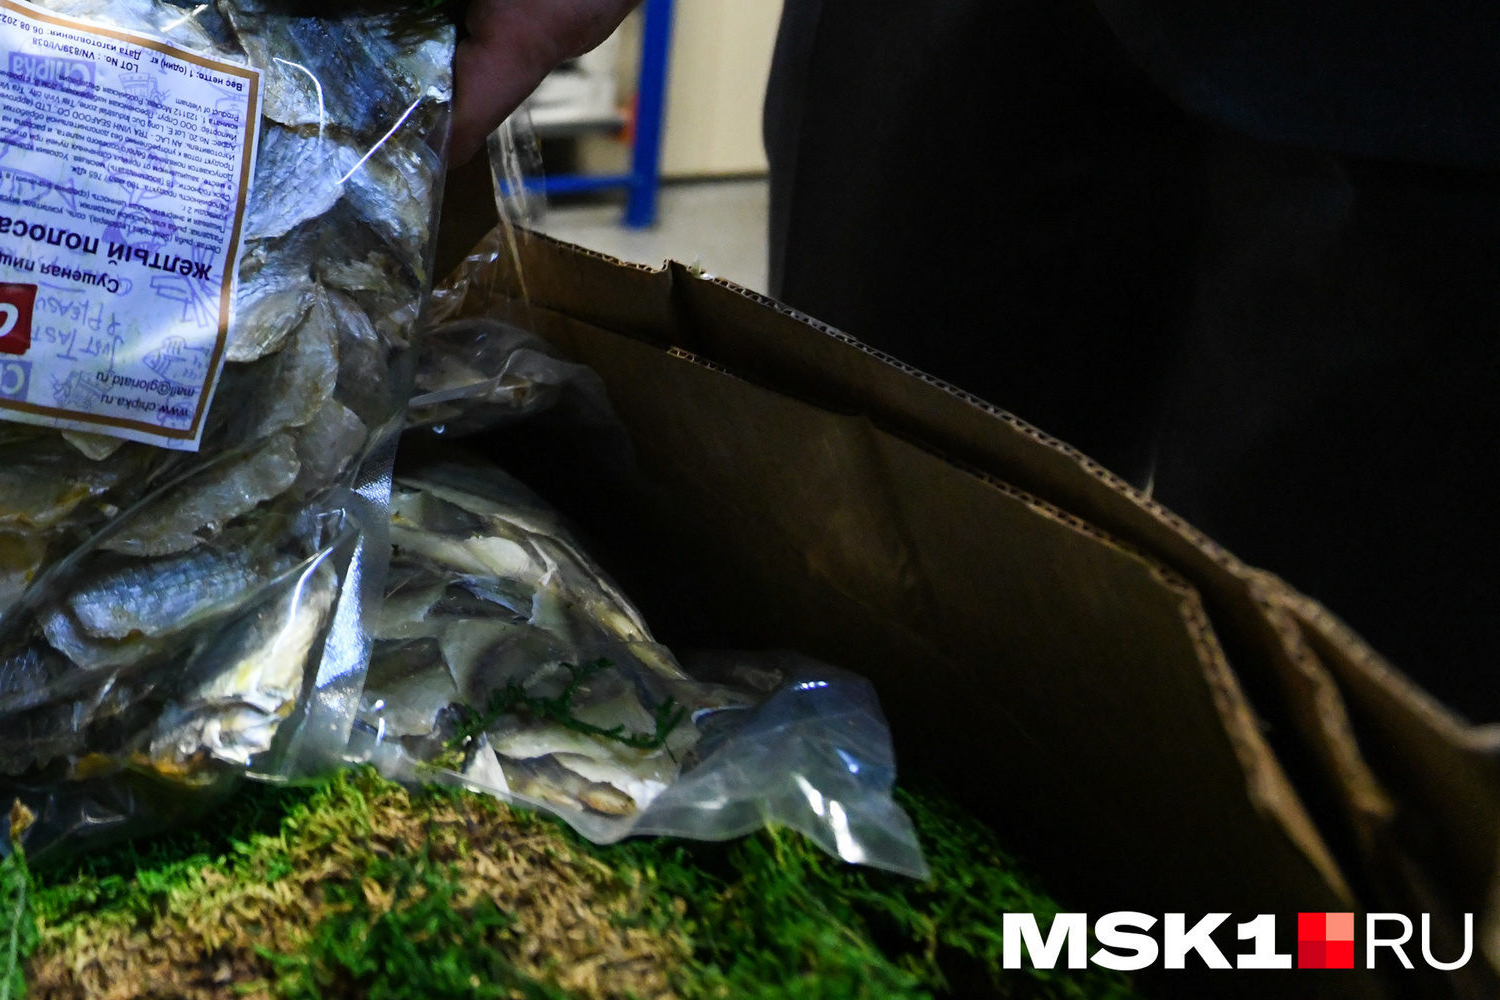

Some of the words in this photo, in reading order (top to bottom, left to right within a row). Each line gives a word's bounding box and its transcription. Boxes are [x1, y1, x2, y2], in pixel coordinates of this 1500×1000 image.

[46, 25, 116, 53] изготовления:
[118, 45, 141, 60] Дата
[119, 60, 139, 73] LOT
[149, 56, 159, 65] кг
[159, 59, 187, 76] (один)
[195, 70, 224, 86] нетто:
[10, 83, 25, 94] Tra
[224, 79, 243, 92] Вес
[42, 92, 60, 103] Vinh
[174, 97, 202, 111] Vietnam
[33, 100, 51, 113] LTD
[202, 105, 211, 114] of
[70, 109, 112, 128] SEAFOOD
[173, 106, 198, 121] 123112
[211, 107, 239, 122] Product
[130, 115, 146, 126] Duc
[146, 119, 164, 132] Long
[178, 119, 198, 131] ООО
[111, 121, 132, 134] VINH
[132, 127, 149, 139] TRA
[173, 128, 186, 138] Lot
[154, 133, 170, 144] LAC
[170, 138, 183, 148] AN
[34, 144, 69, 161] Условия
[182, 151, 202, 162] готов
[183, 140, 235, 161] Изготовитель:
[203, 156, 234, 172] Продукт
[87, 169, 102, 180] 765
[186, 161, 234, 182] Допускается
[177, 191, 229, 213] Калорийность
[212, 189, 231, 202] Срок
[173, 234, 193, 246] рыба
[107, 240, 213, 284] желтый
[40, 257, 120, 294] Сушеная
[96, 371, 197, 398] mail@gloriatd.ru
[102, 395, 190, 418] www.chipka.ru
